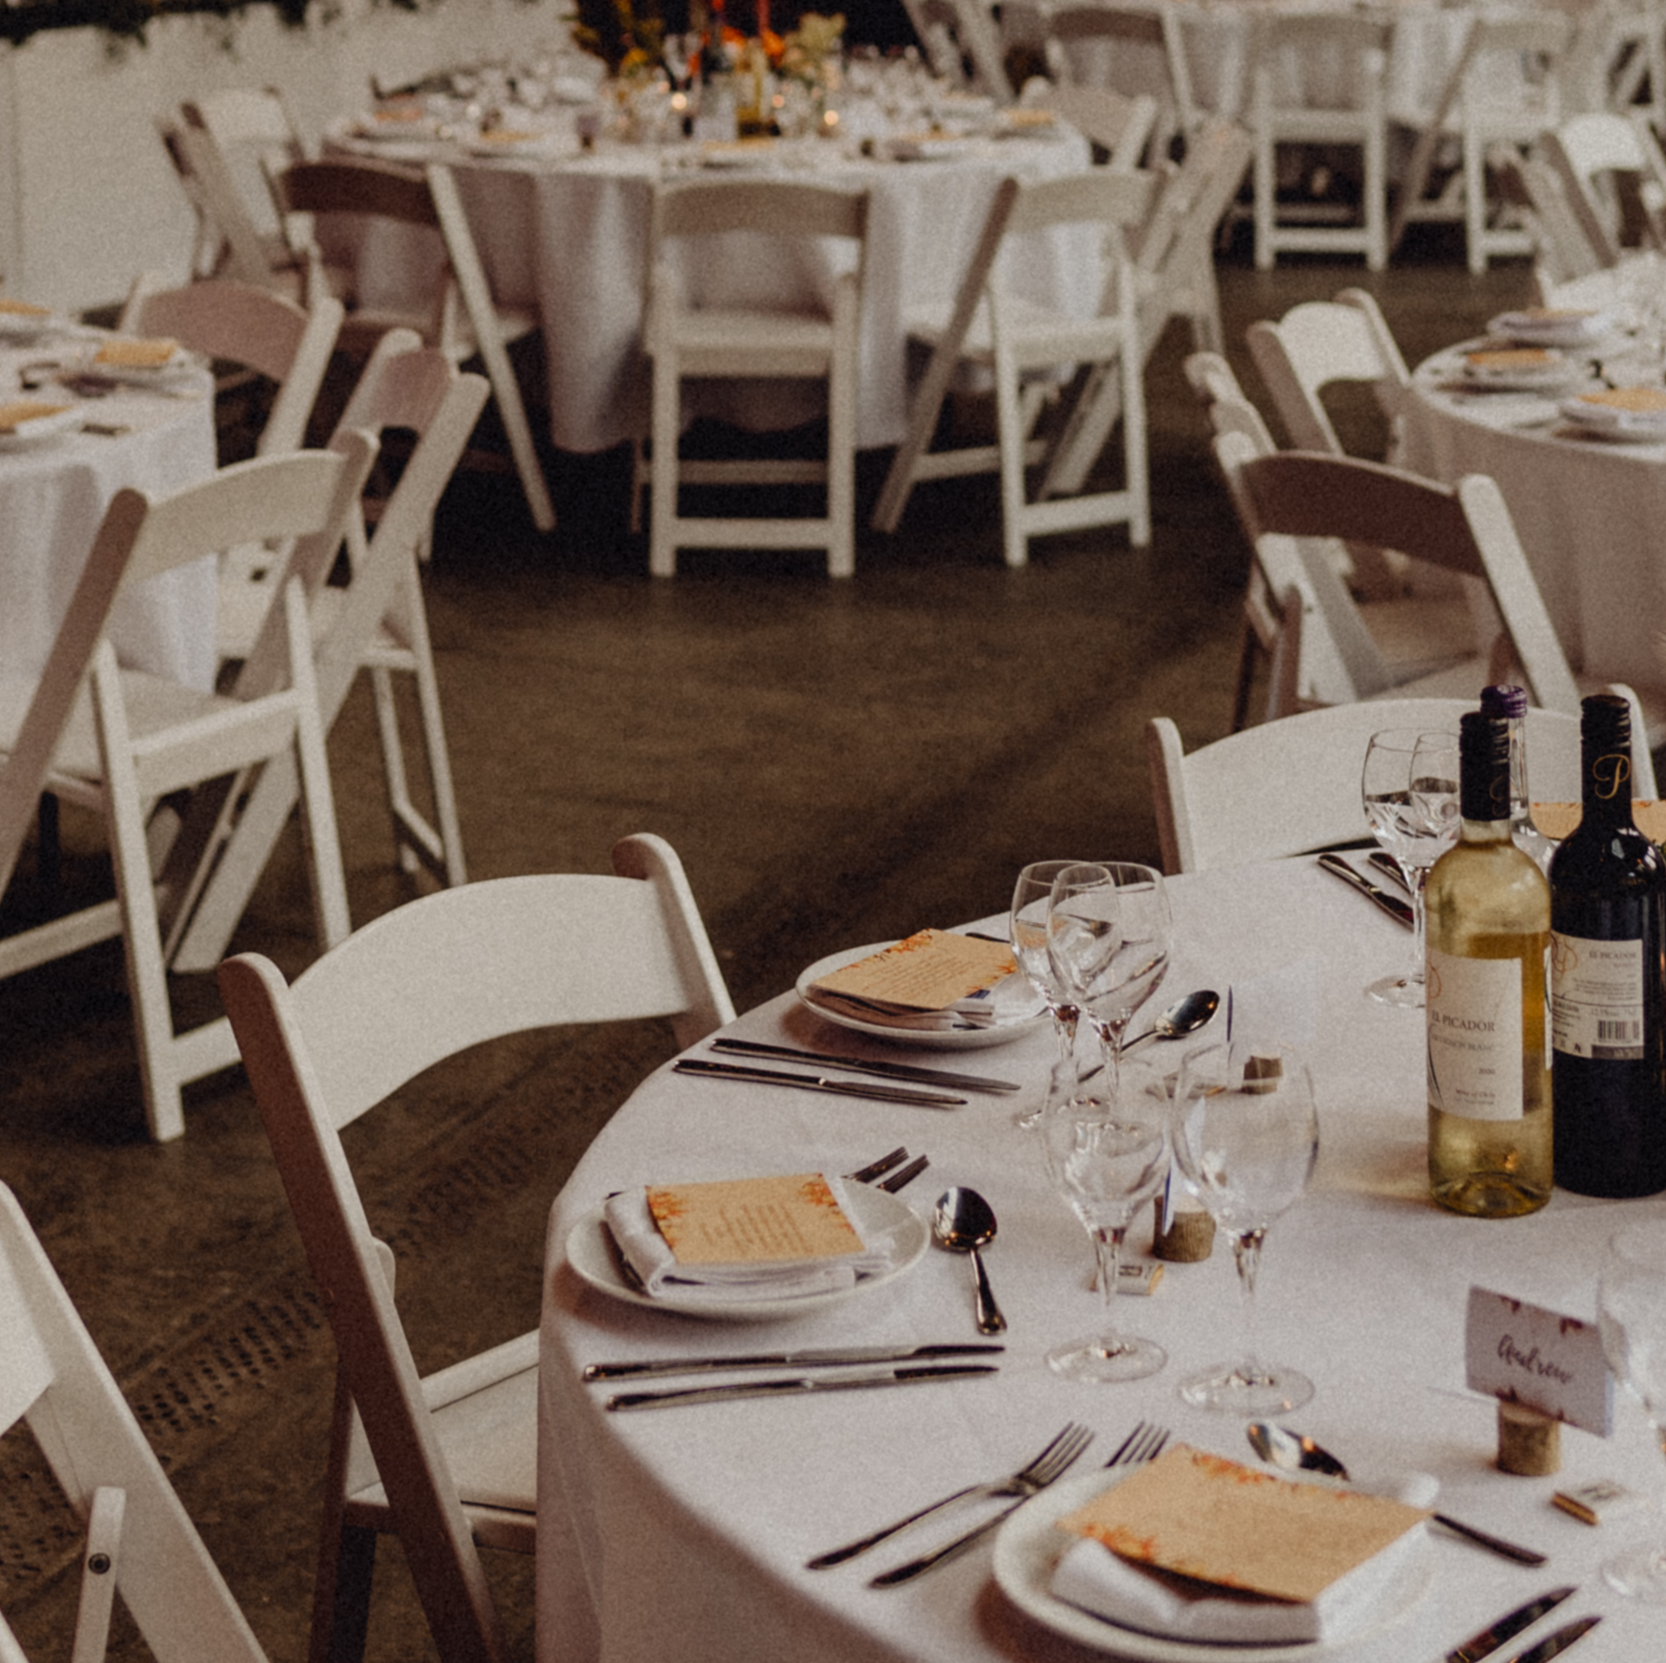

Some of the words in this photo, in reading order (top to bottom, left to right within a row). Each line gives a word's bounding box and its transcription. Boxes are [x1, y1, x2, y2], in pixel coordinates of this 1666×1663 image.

[1593, 753, 1631, 800] P
[1432, 1010, 1441, 1024] EL
[1442, 1014, 1496, 1033] PICADOR
[1497, 1333, 1574, 1384] Andrew
